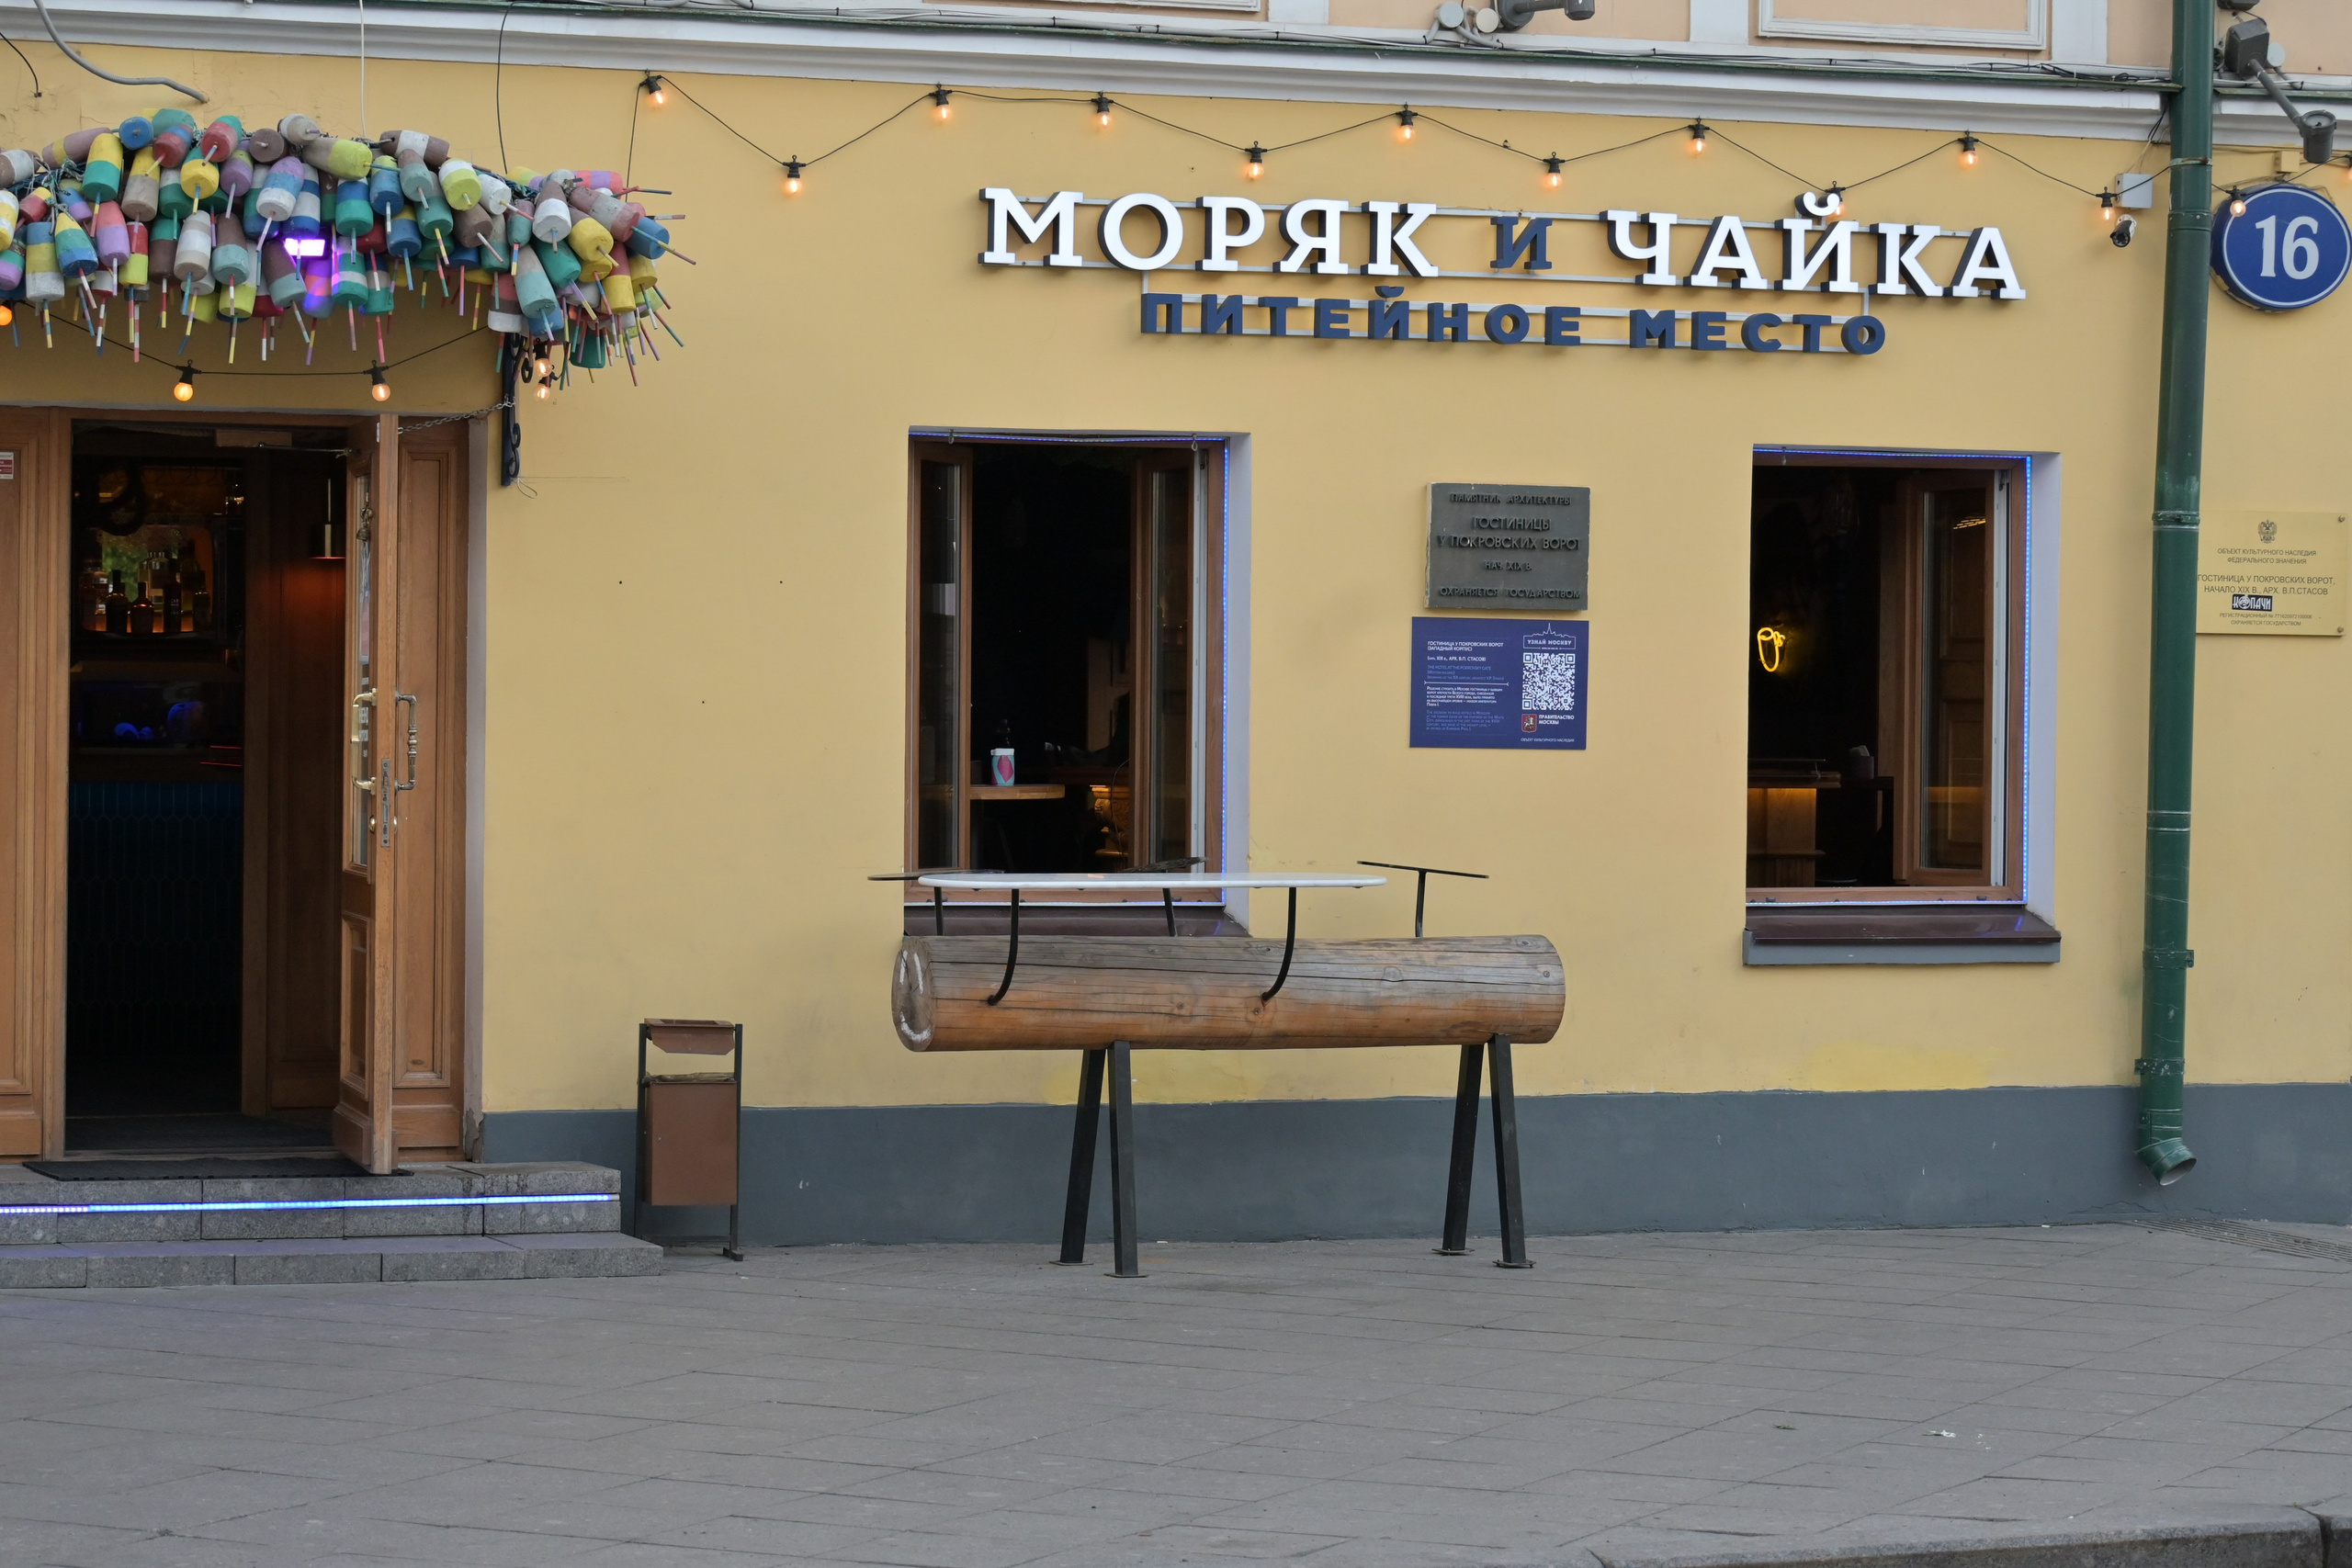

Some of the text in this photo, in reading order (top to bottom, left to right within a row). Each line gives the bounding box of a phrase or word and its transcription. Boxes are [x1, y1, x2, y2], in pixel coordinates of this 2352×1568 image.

[978, 186, 2026, 300] МОРЯК И ЧАЙКА
[2256, 214, 2320, 280] 16
[1141, 286, 1886, 355] ПИТЕЙНОЕ МЕСТО
[1450, 493, 1572, 506] ПАМЯТНИК АРХИТЕКТУРЫ
[1473, 517, 1552, 531] ГОСТИНИЦЫ
[1438, 536, 1579, 551] У ПОКРОВСКИХ ВОРОТ
[2198, 574, 2245, 583] ГОСТИНИЦА
[2253, 575, 2305, 583] ПОКРОВСКИХ
[1440, 586, 1581, 599] ОХРАНЯЕТСЯ ГОСУДАРСТВОМ
[2204, 585, 2236, 593] НАЧАЛО
[2263, 586, 2279, 594] АРХ.
